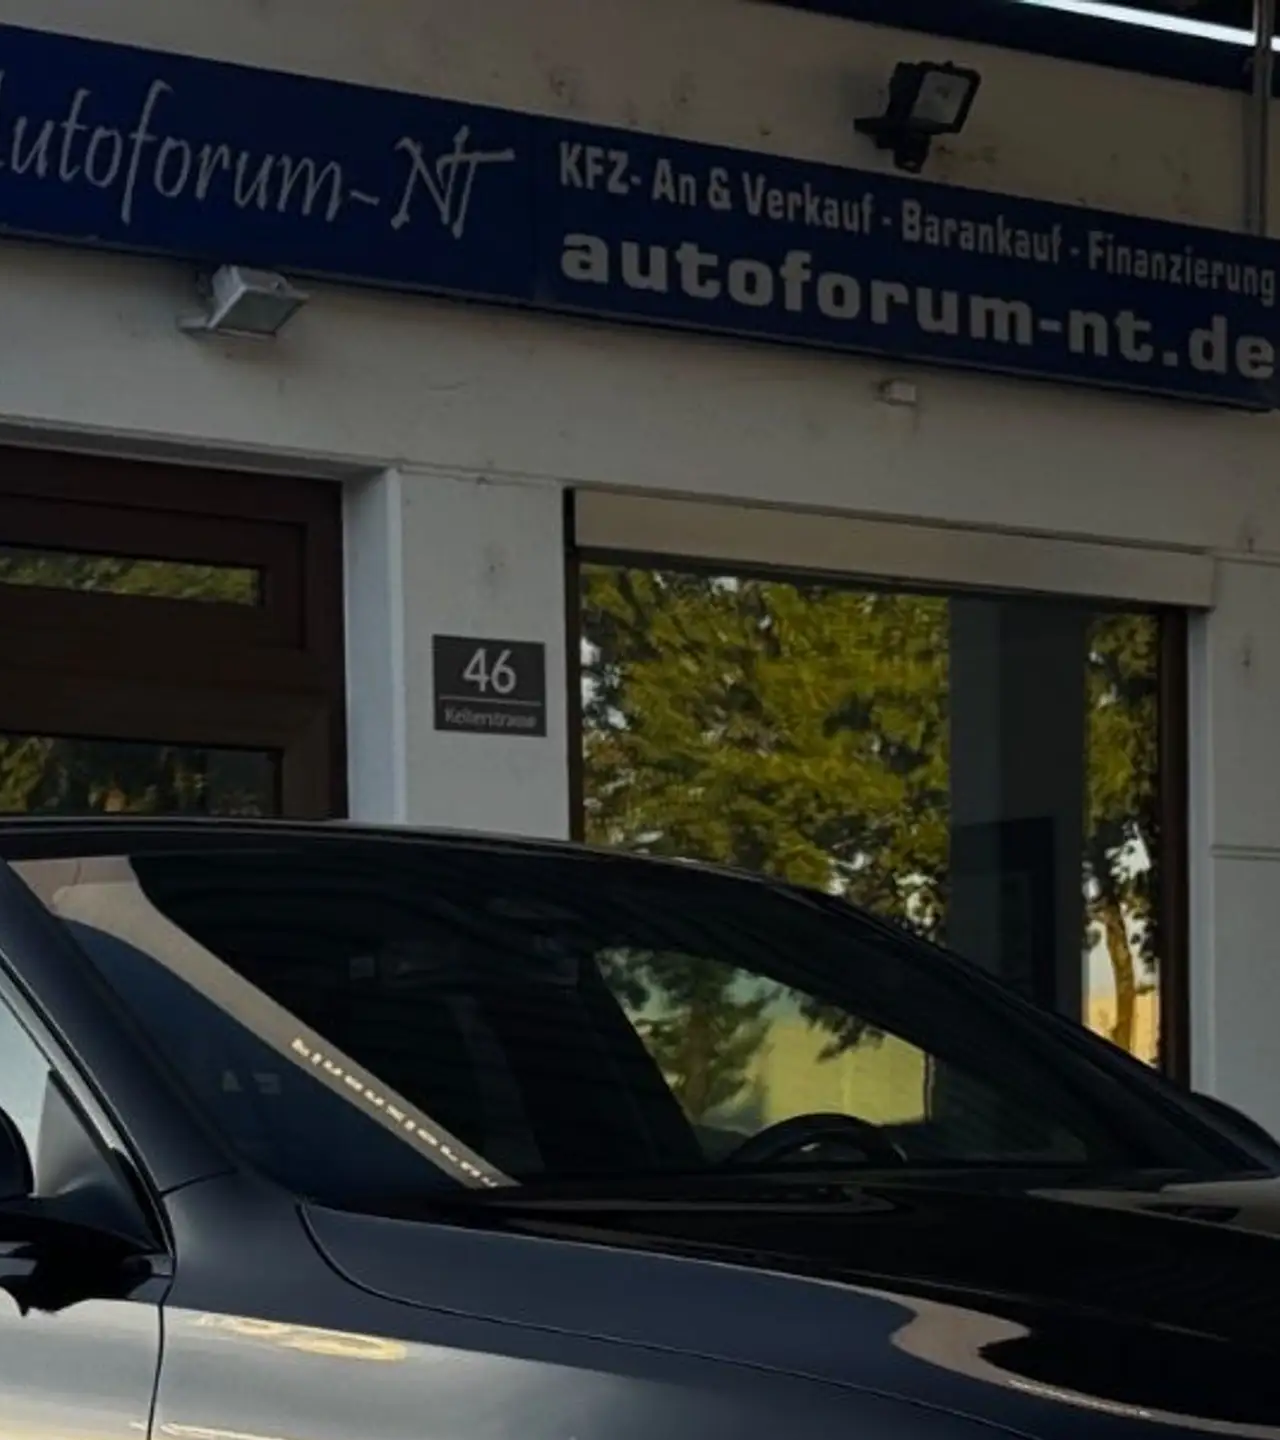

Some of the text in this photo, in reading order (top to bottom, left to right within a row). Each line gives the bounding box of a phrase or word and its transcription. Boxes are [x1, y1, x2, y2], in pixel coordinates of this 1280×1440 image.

[558, 140, 642, 196] KFZ-
[651, 157, 697, 208] An
[707, 166, 732, 212] &
[742, 171, 875, 236] Verkauf
[901, 197, 1063, 265] Barankauf
[1087, 229, 1276, 308] Finanzierung
[560, 232, 1275, 381] autoforum-nt.de
[462, 647, 517, 695] 46
